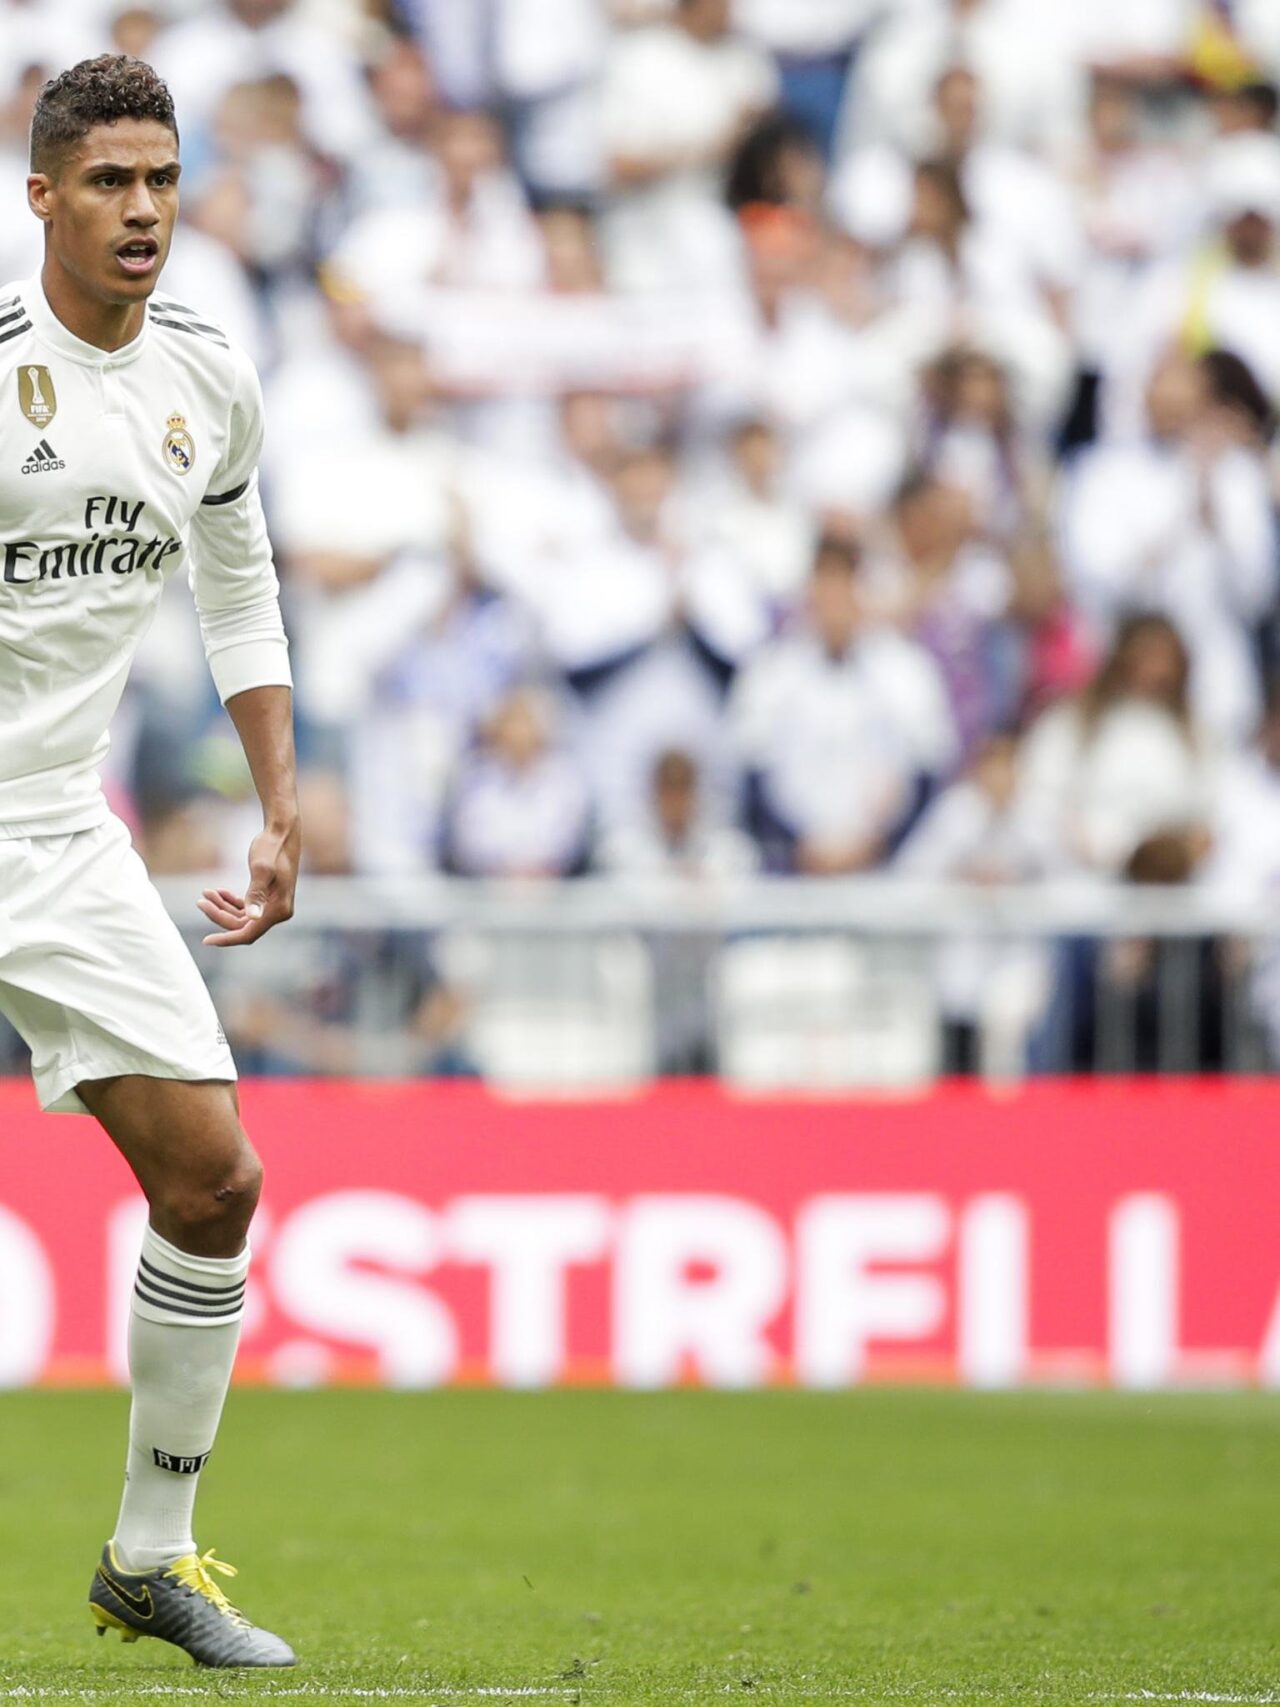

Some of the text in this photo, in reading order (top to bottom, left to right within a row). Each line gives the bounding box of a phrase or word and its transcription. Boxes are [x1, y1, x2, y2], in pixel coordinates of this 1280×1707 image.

[20, 459, 66, 475] adidas
[85, 496, 146, 532] Fly
[3, 532, 183, 584] Emirate
[104, 1188, 1280, 1390] STRELL
